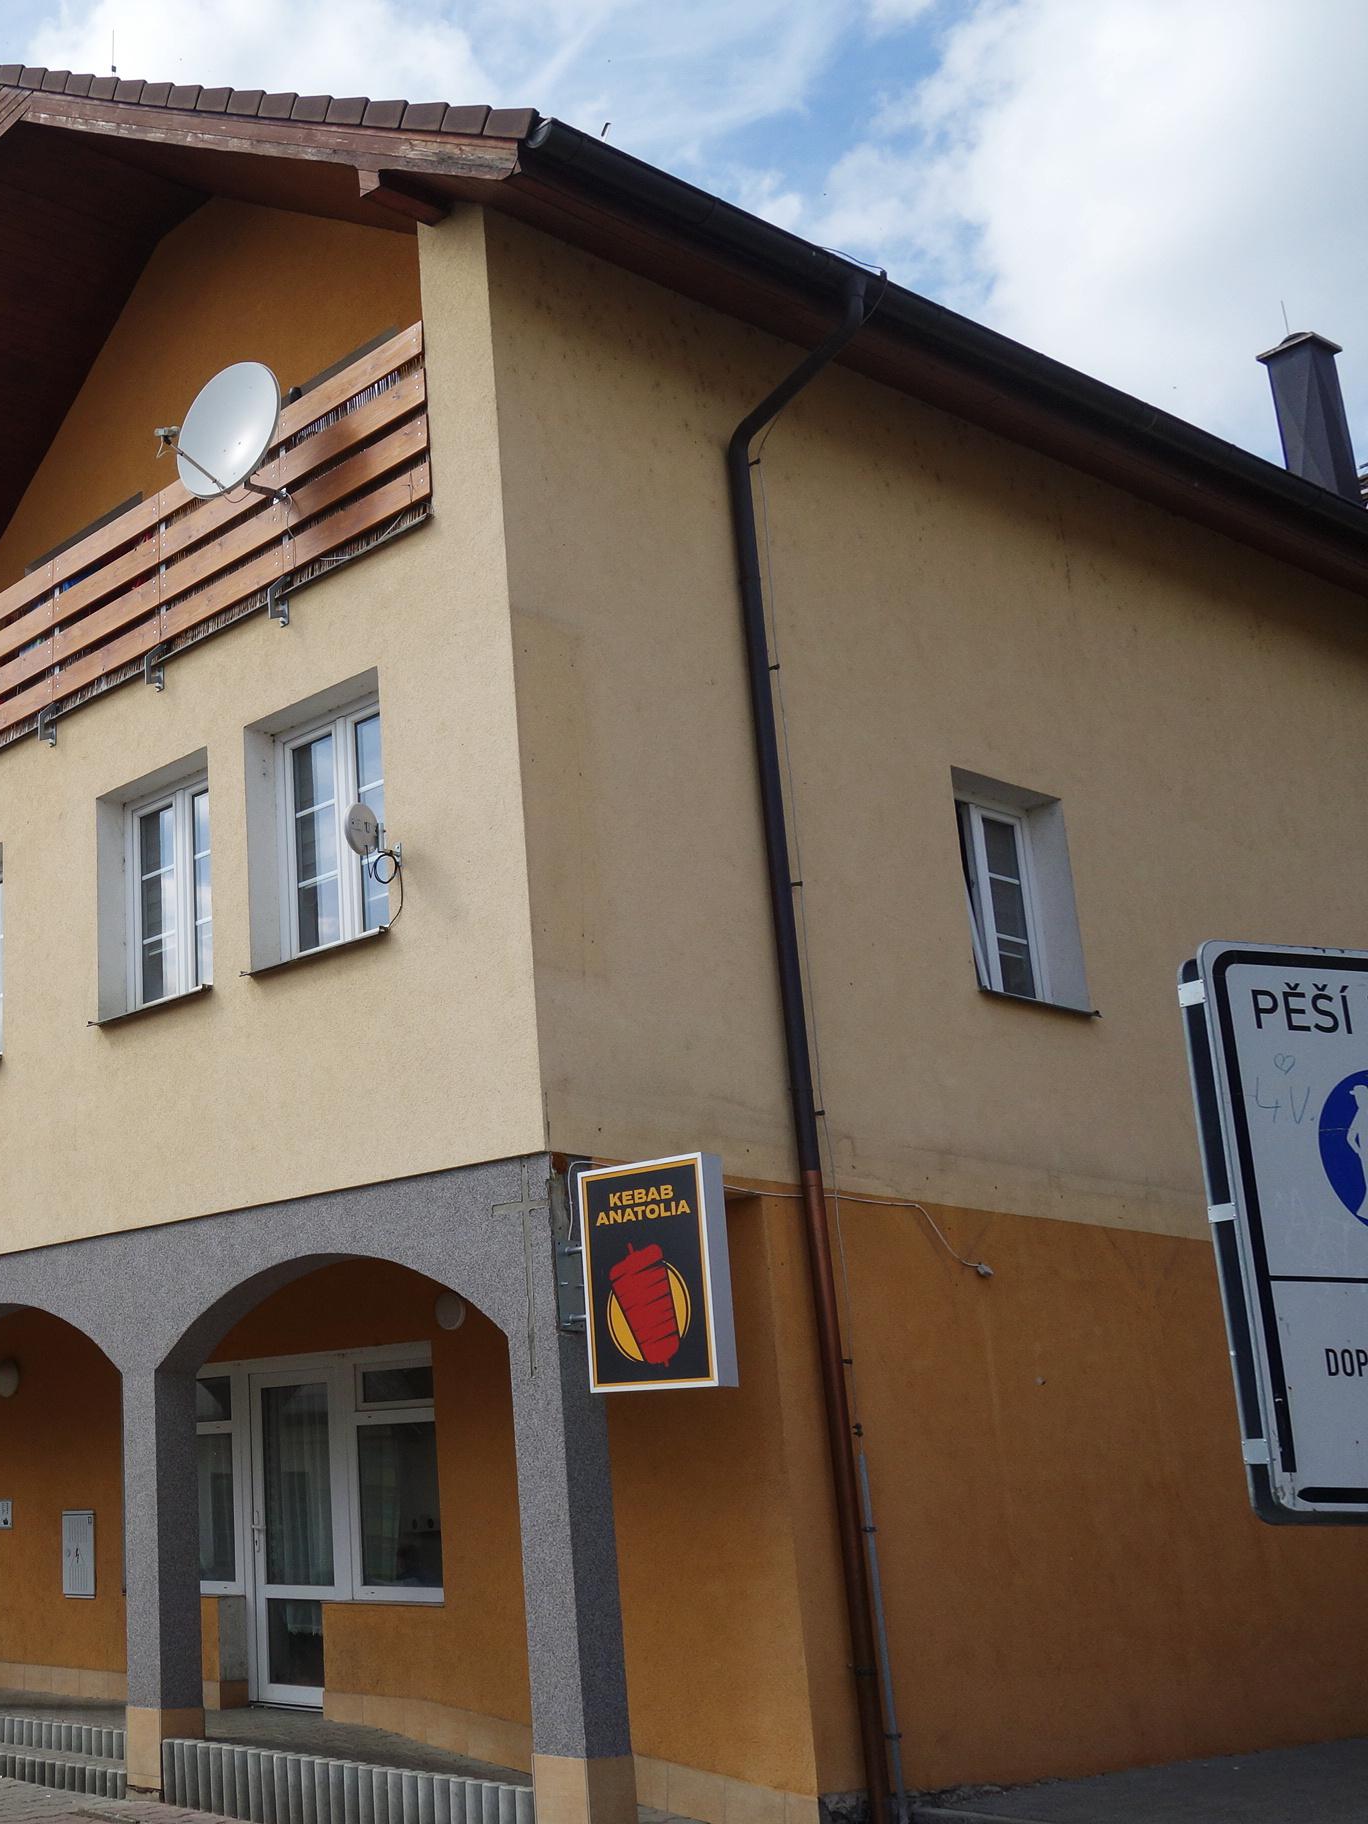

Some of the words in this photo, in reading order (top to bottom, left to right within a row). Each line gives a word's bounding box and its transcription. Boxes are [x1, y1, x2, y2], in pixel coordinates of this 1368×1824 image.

[1251, 982, 1353, 1034] PĚŠÍ
[609, 1184, 674, 1207] KEBAB
[596, 1199, 691, 1226] ANATOLIA
[1324, 1348, 1368, 1377] DOP
